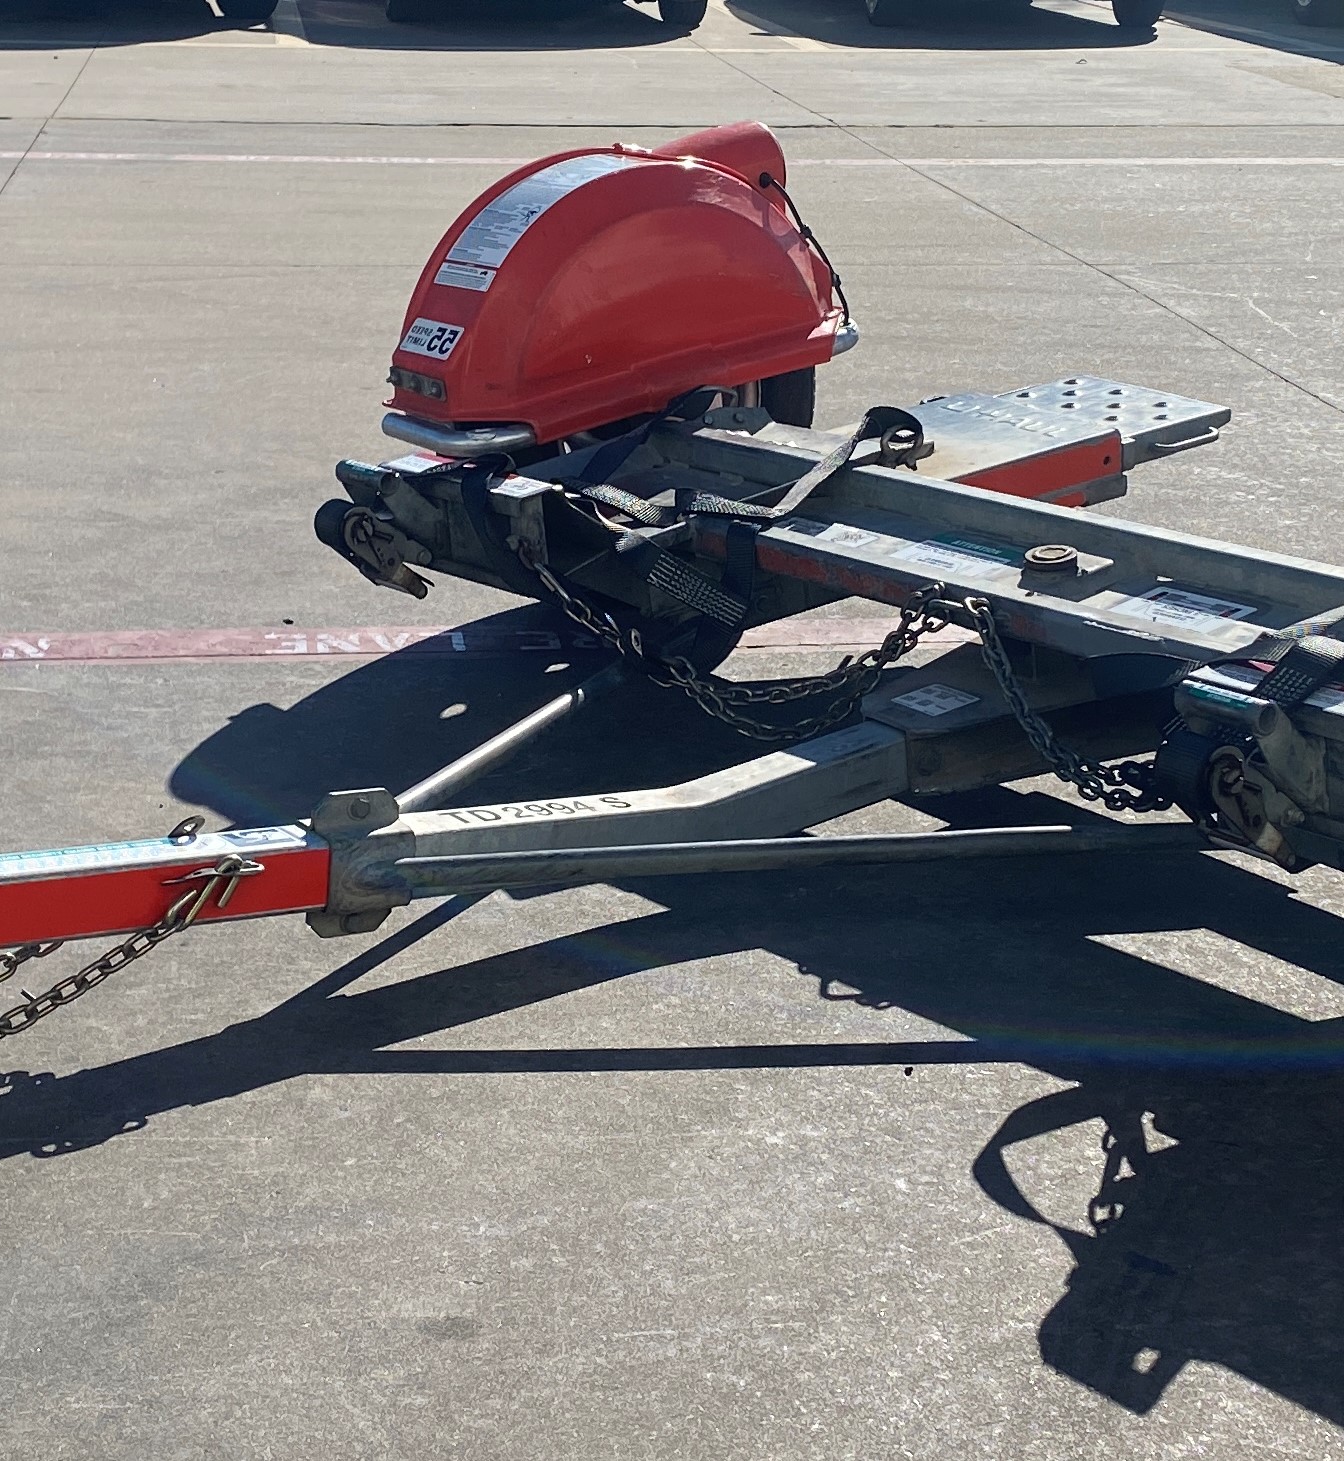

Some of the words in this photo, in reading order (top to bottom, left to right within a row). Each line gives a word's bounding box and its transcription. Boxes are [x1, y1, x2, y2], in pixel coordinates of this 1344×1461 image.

[265, 631, 467, 654] LANE
[440, 808, 502, 825] TD
[501, 799, 596, 819] 2994
[599, 796, 632, 809] S
